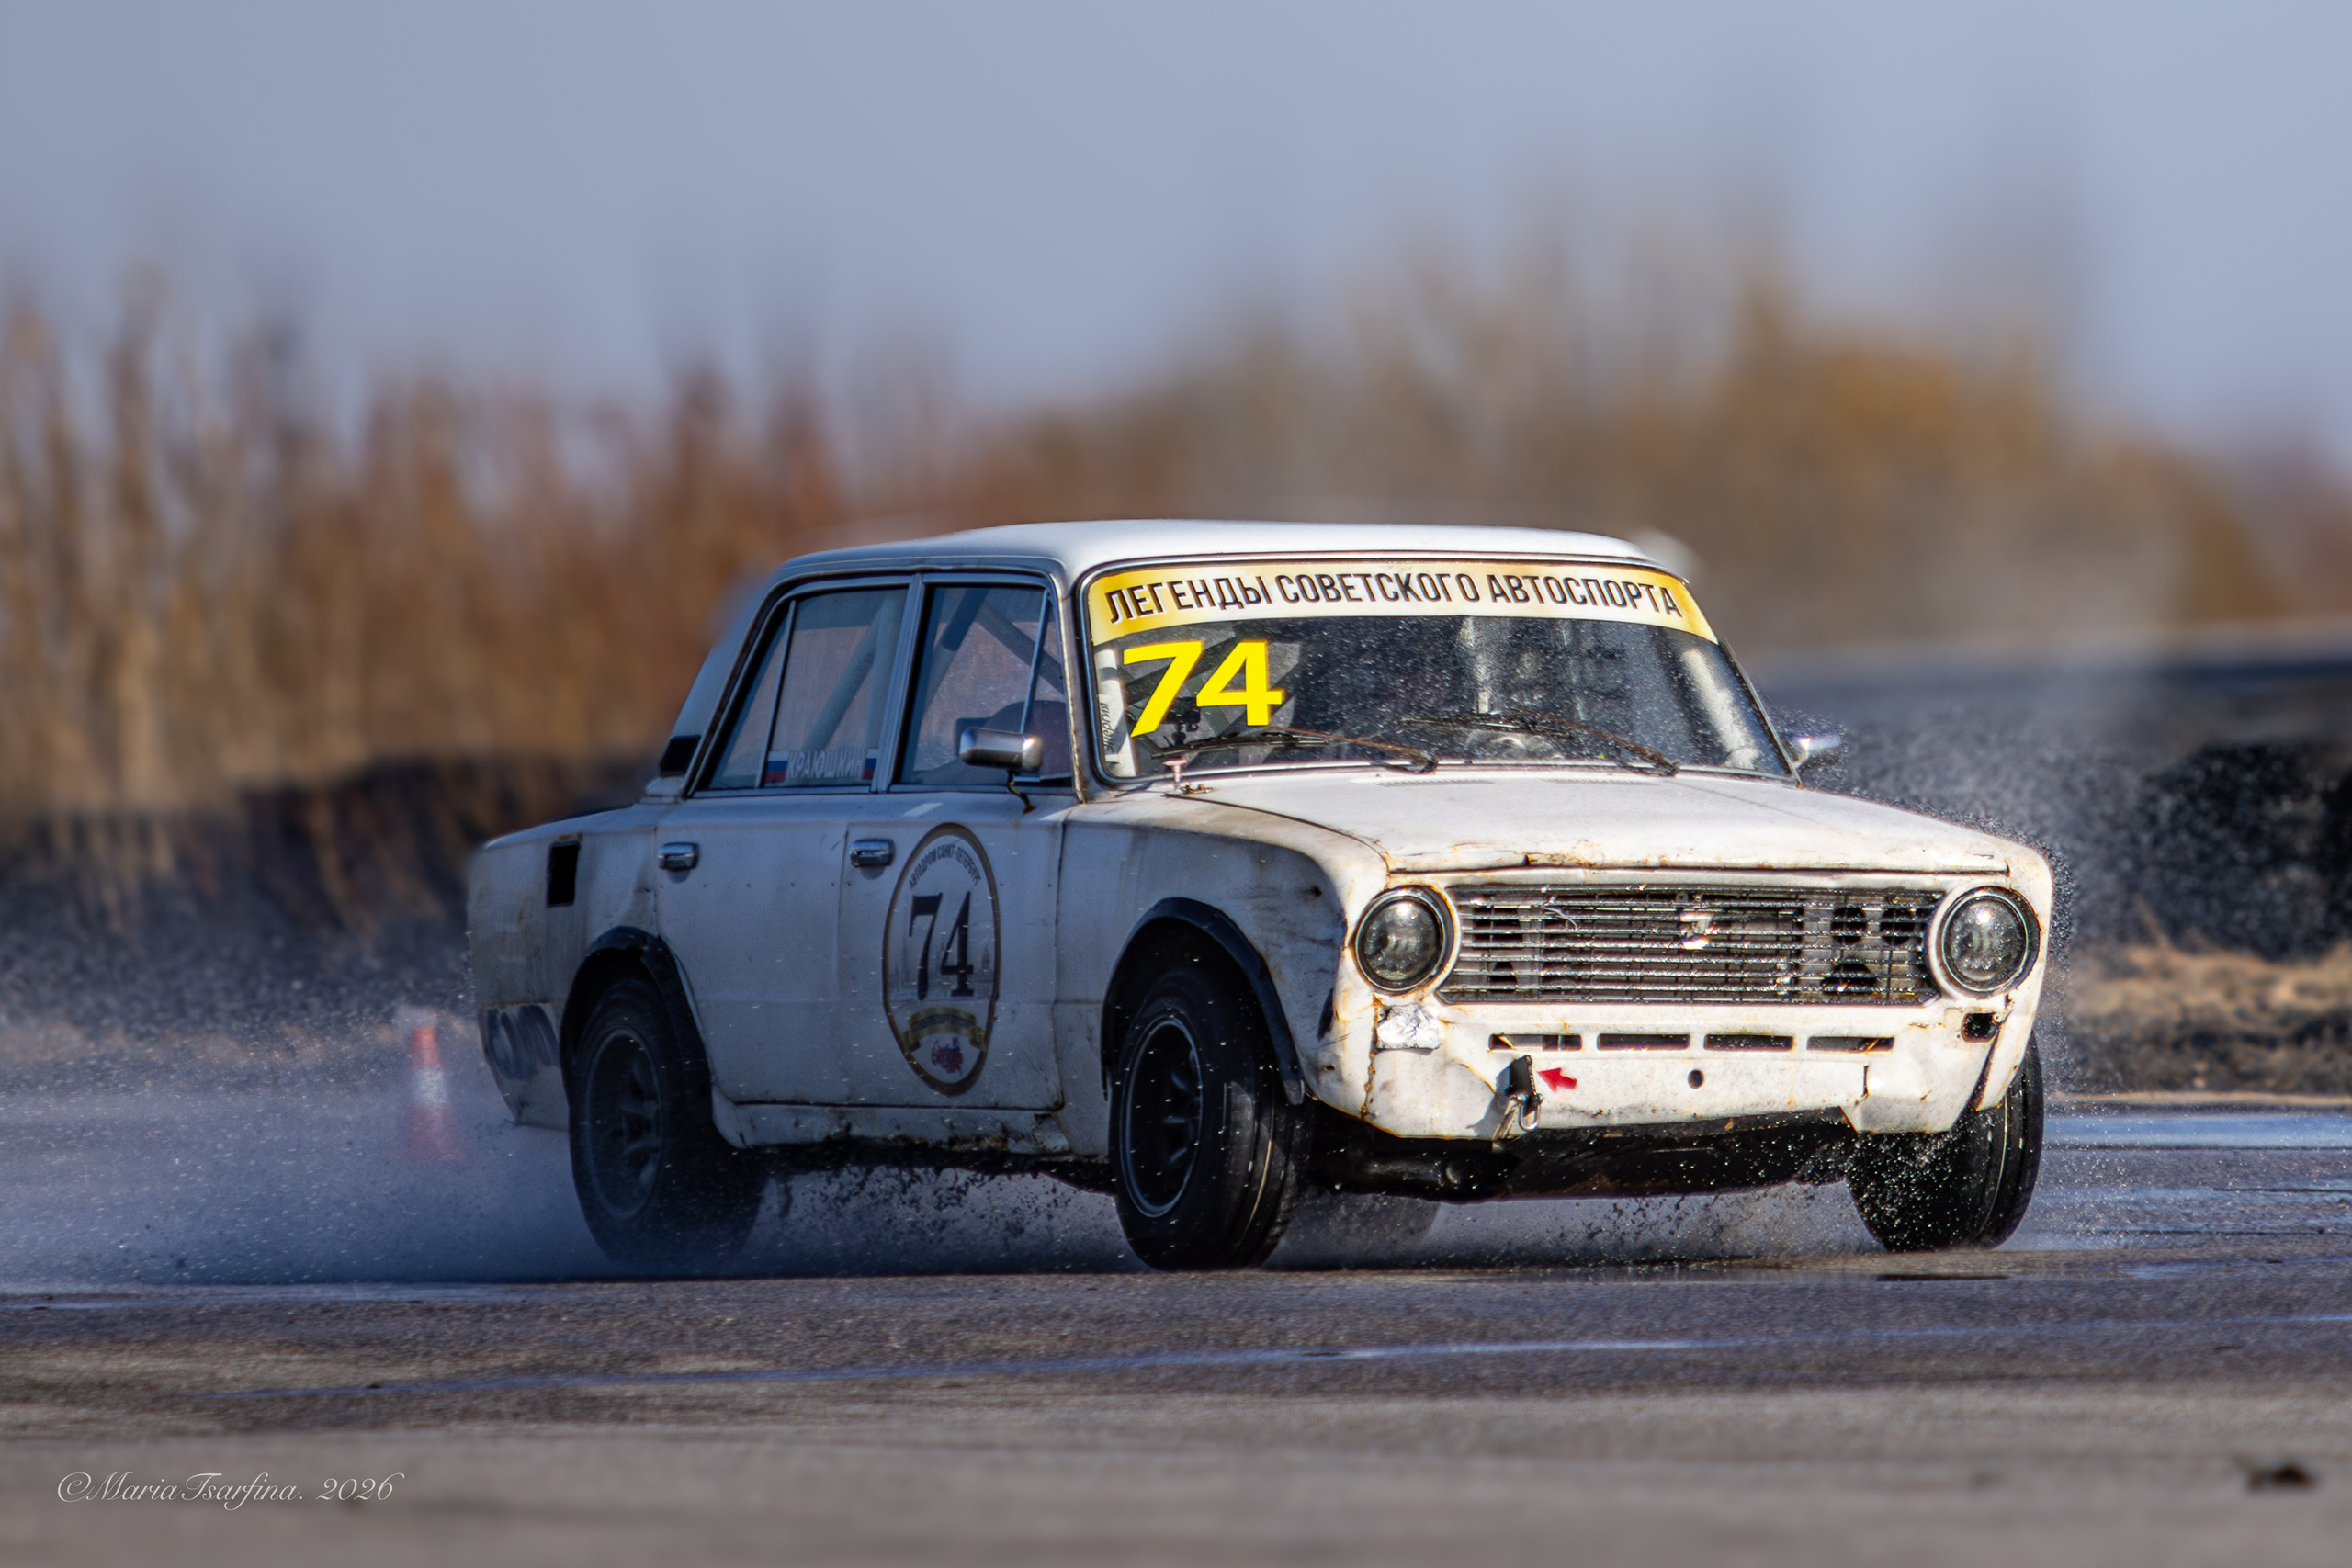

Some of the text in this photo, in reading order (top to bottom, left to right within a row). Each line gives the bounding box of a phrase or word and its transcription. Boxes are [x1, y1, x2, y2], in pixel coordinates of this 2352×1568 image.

[1104, 571, 1680, 624] ЛЕГЕНДЫ СОВЕТСКОГО АВТОСПОРТА
[1123, 639, 1284, 738] 74
[786, 750, 865, 779] КРАЮШКИН
[909, 891, 974, 1000] 74
